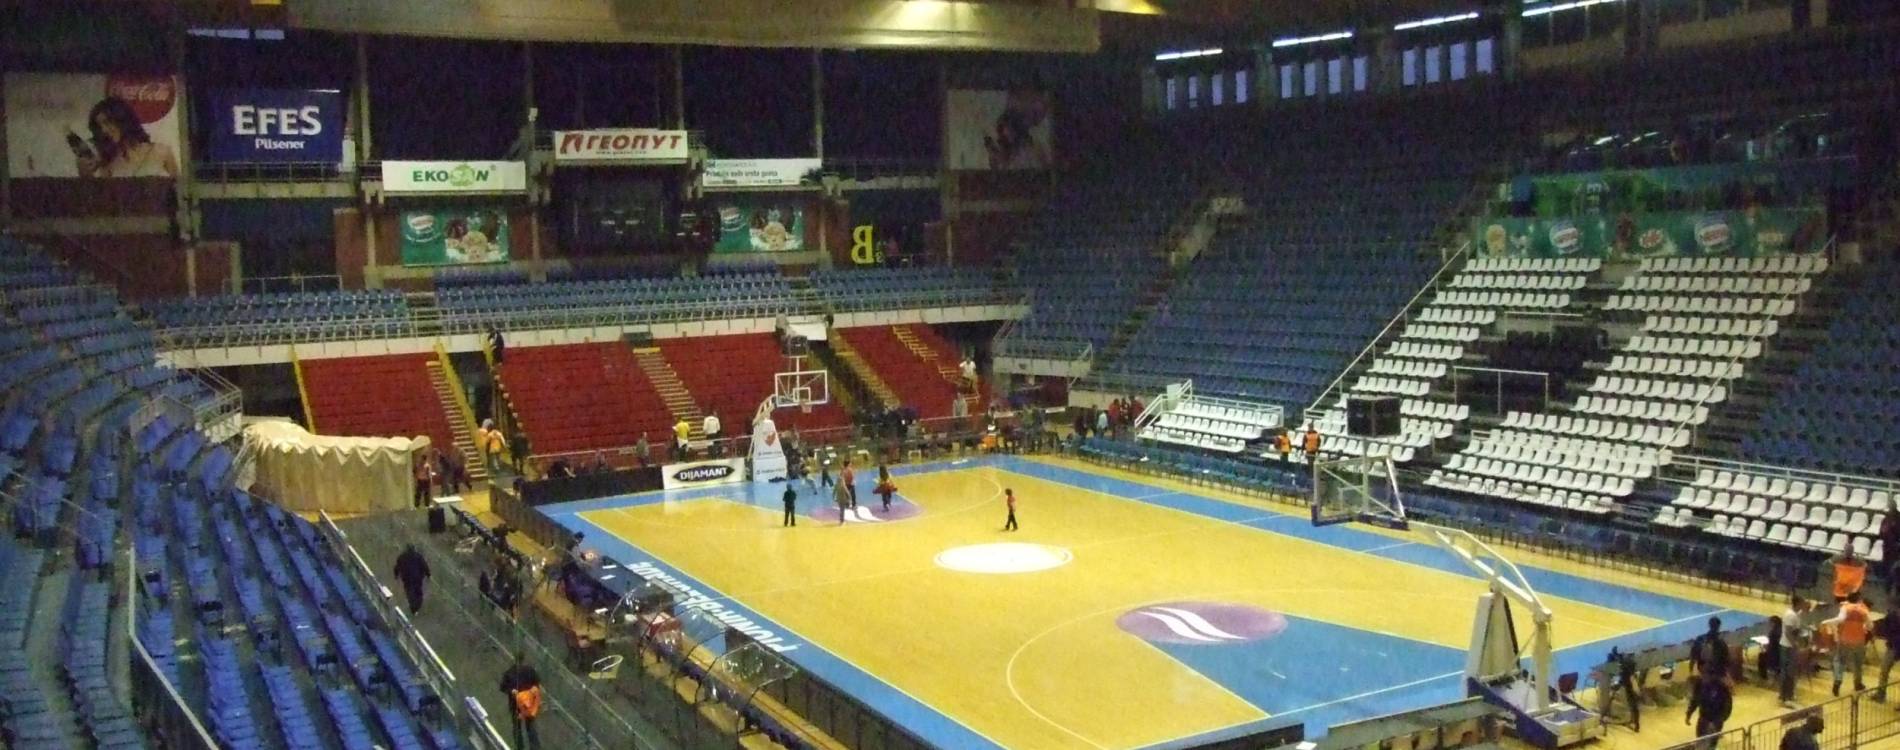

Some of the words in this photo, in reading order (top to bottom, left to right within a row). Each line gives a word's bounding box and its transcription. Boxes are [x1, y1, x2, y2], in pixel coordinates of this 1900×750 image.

[232, 105, 322, 136] EFES
[254, 138, 306, 150] Pilsener
[679, 466, 728, 481] DIJAMANT
